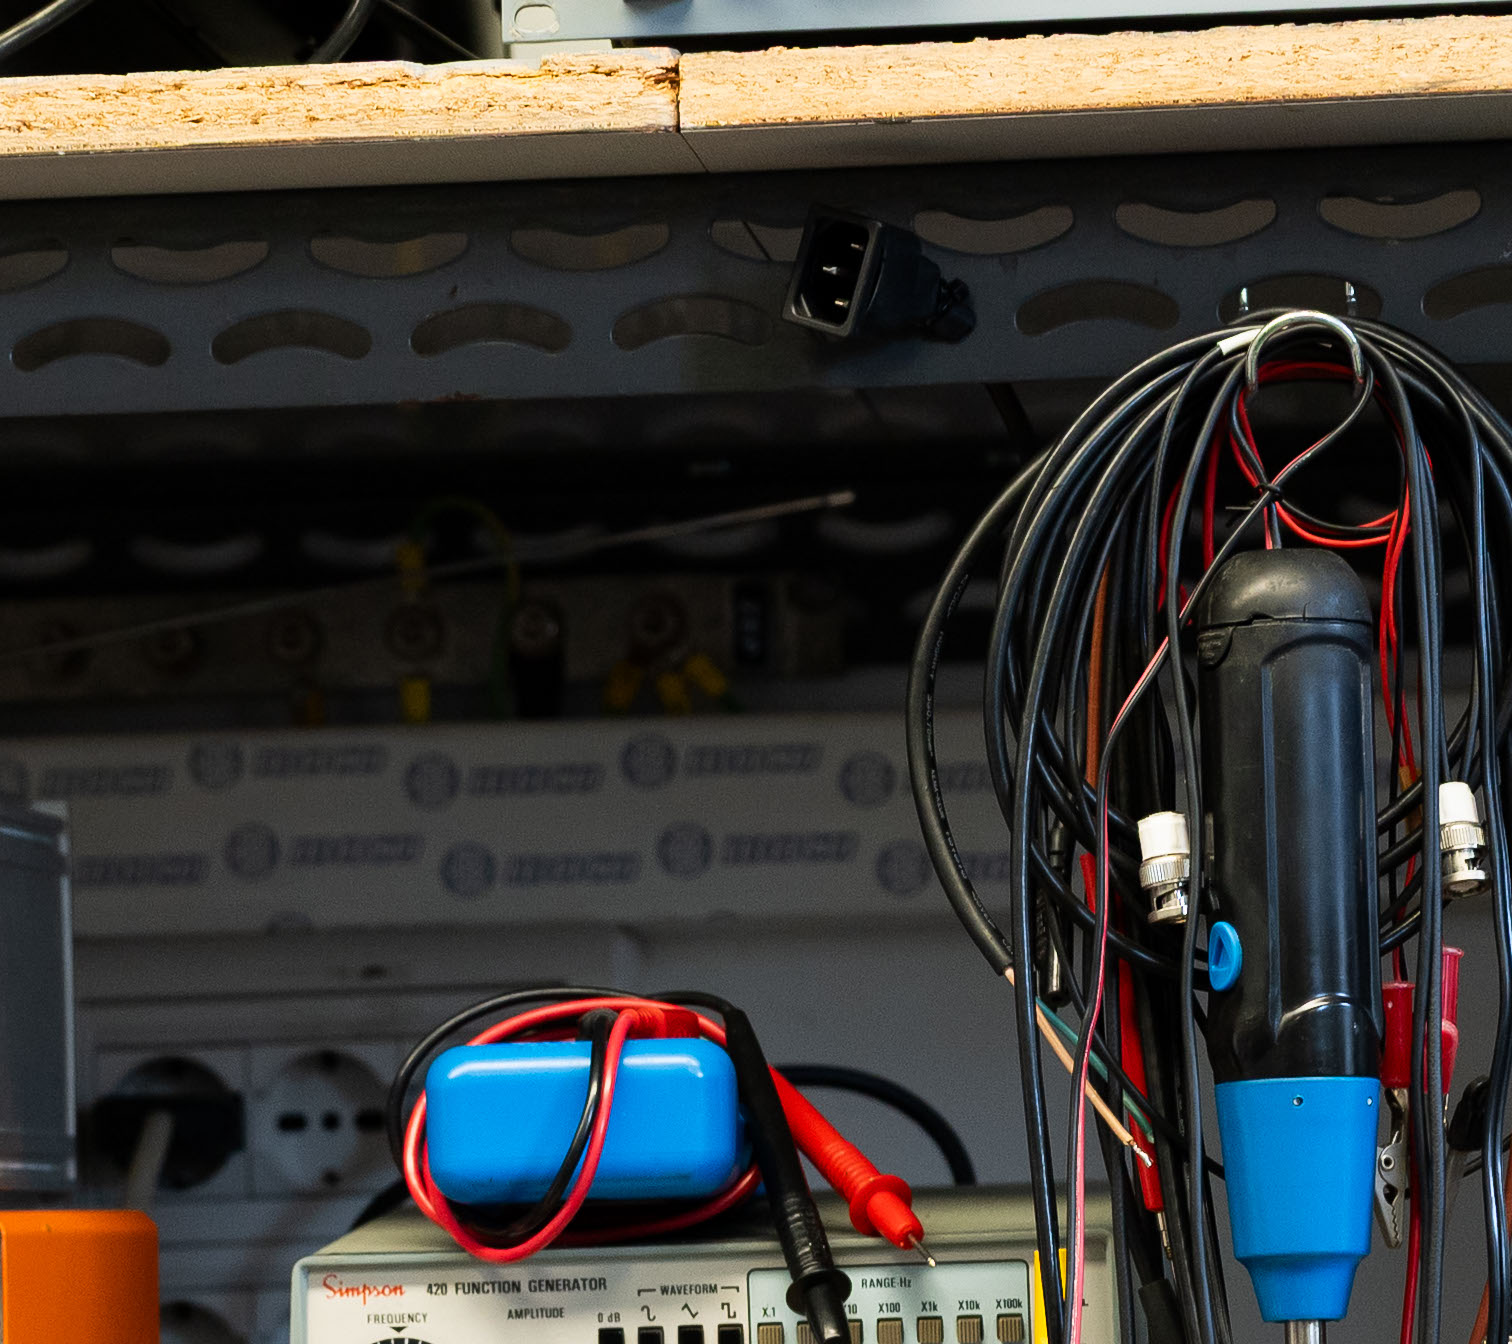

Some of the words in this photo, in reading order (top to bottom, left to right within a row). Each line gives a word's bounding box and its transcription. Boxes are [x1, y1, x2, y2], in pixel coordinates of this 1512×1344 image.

[321, 1273, 406, 1306] Simpson
[426, 1283, 448, 1296] 420
[455, 1280, 522, 1296] FUNCTION
[528, 1277, 608, 1293] GENERATOR
[660, 1284, 719, 1296] WAVEFORM
[878, 1302, 901, 1314] X100
[921, 1301, 938, 1313] X1k
[957, 1299, 980, 1311] X10k
[995, 1298, 1023, 1310] X100k
[367, 1312, 428, 1325] FREQUENCY
[507, 1307, 565, 1321] AMPLITUDE
